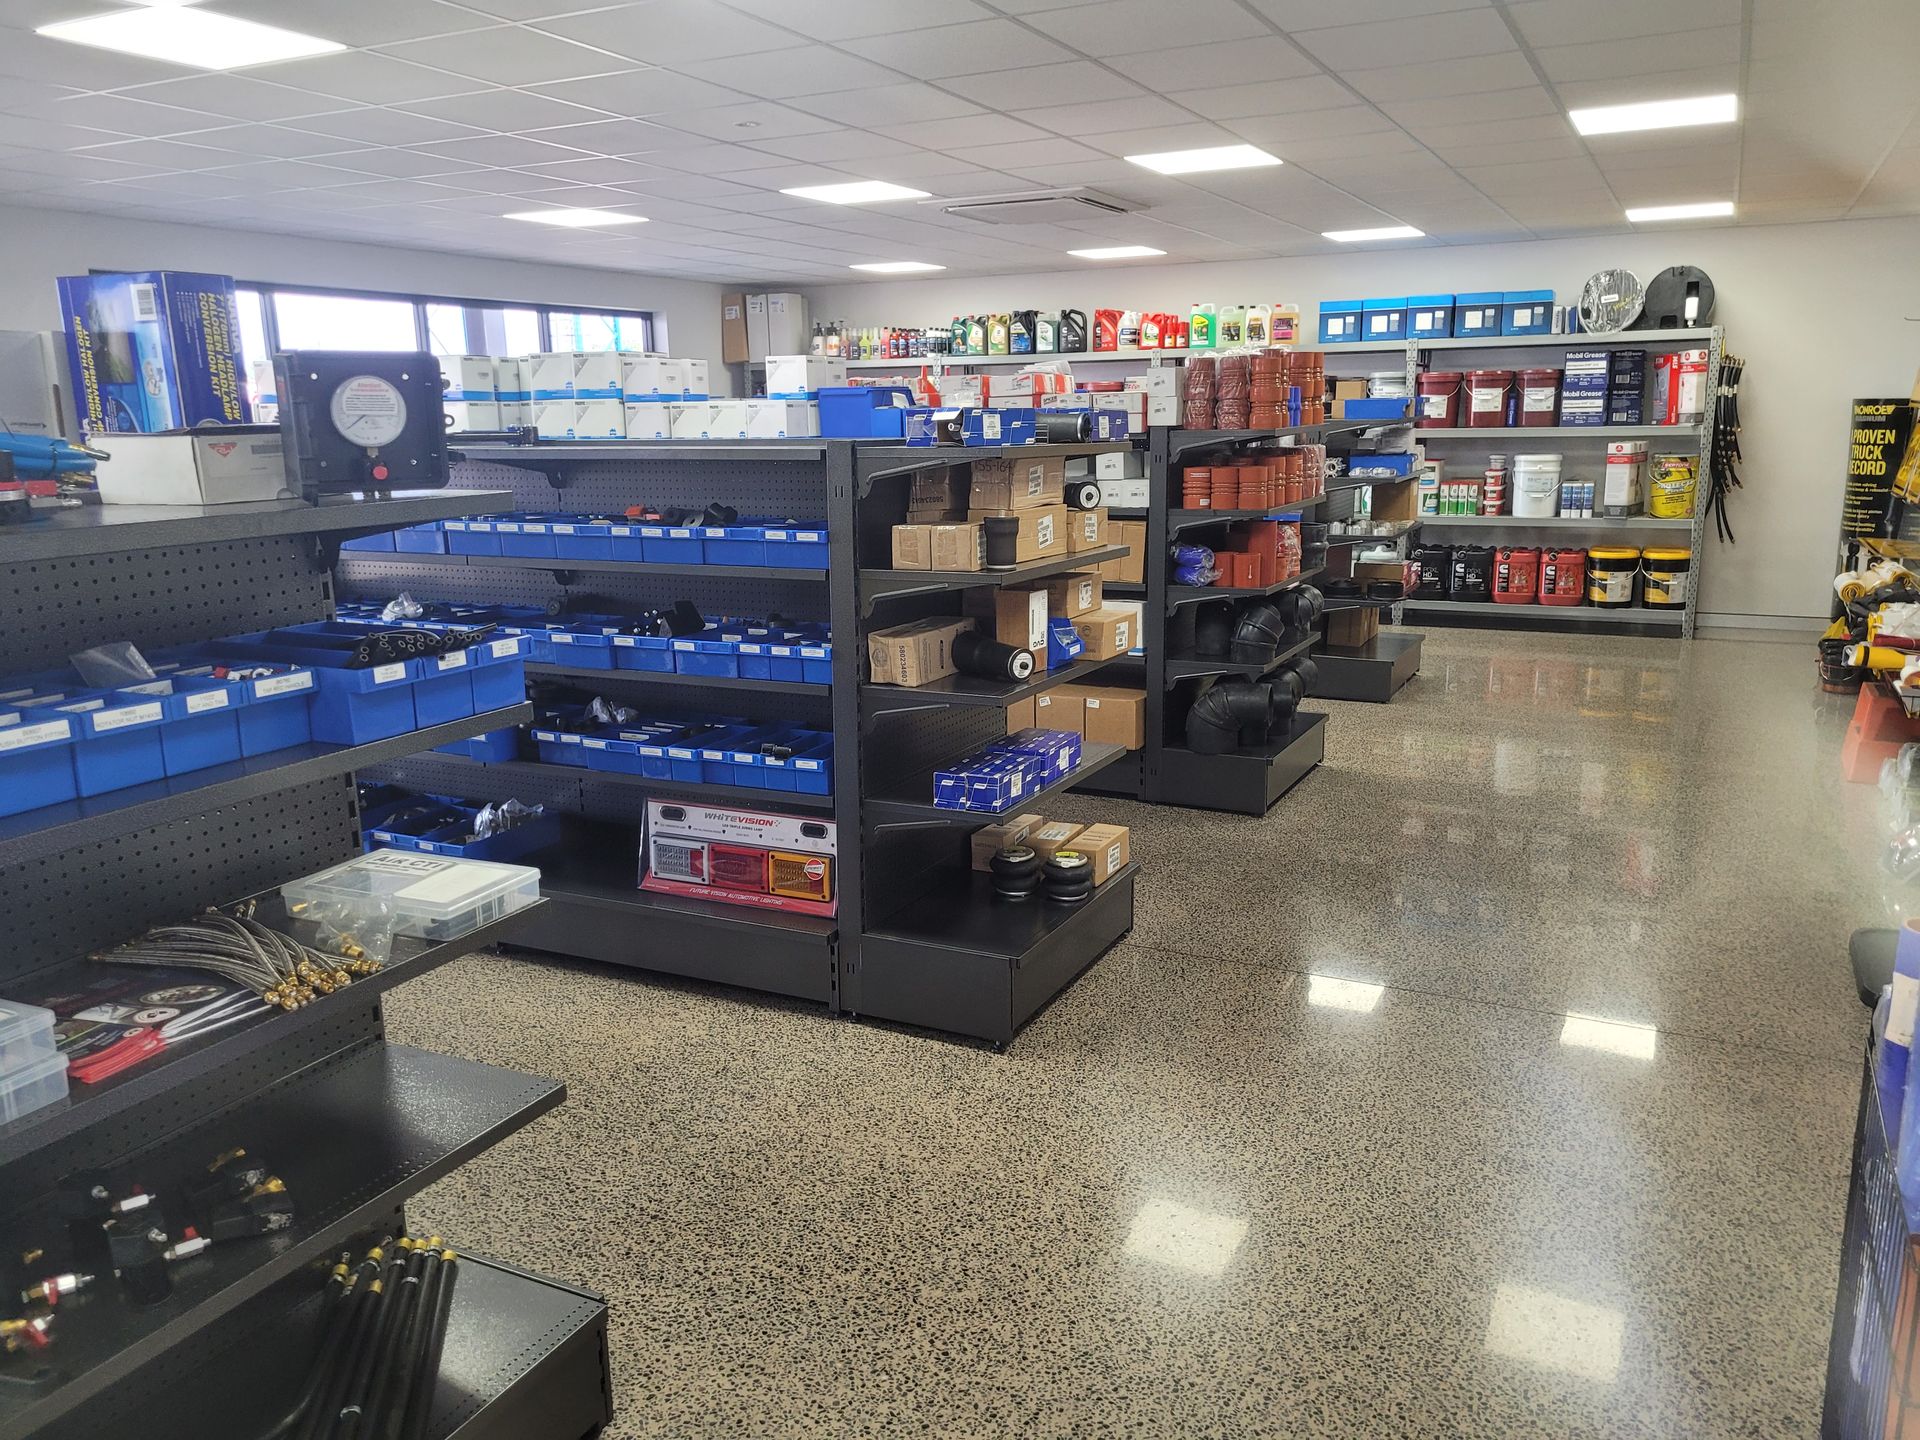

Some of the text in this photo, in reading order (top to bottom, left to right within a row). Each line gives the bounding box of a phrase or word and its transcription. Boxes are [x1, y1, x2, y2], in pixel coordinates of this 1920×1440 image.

[83, 329, 93, 348] KIT
[199, 292, 222, 398] CONVERSION KIT
[207, 292, 234, 422] HALOGEN HEADLAMP
[87, 350, 104, 419] CONVERSION
[1562, 390, 1580, 398] Mobil
[1853, 429, 1896, 445] PROVEN
[1851, 445, 1883, 460] TRUCK
[373, 855, 410, 865] AIR
[409, 860, 446, 869] CTI
[728, 892, 760, 902] AUTOMOTIVE
